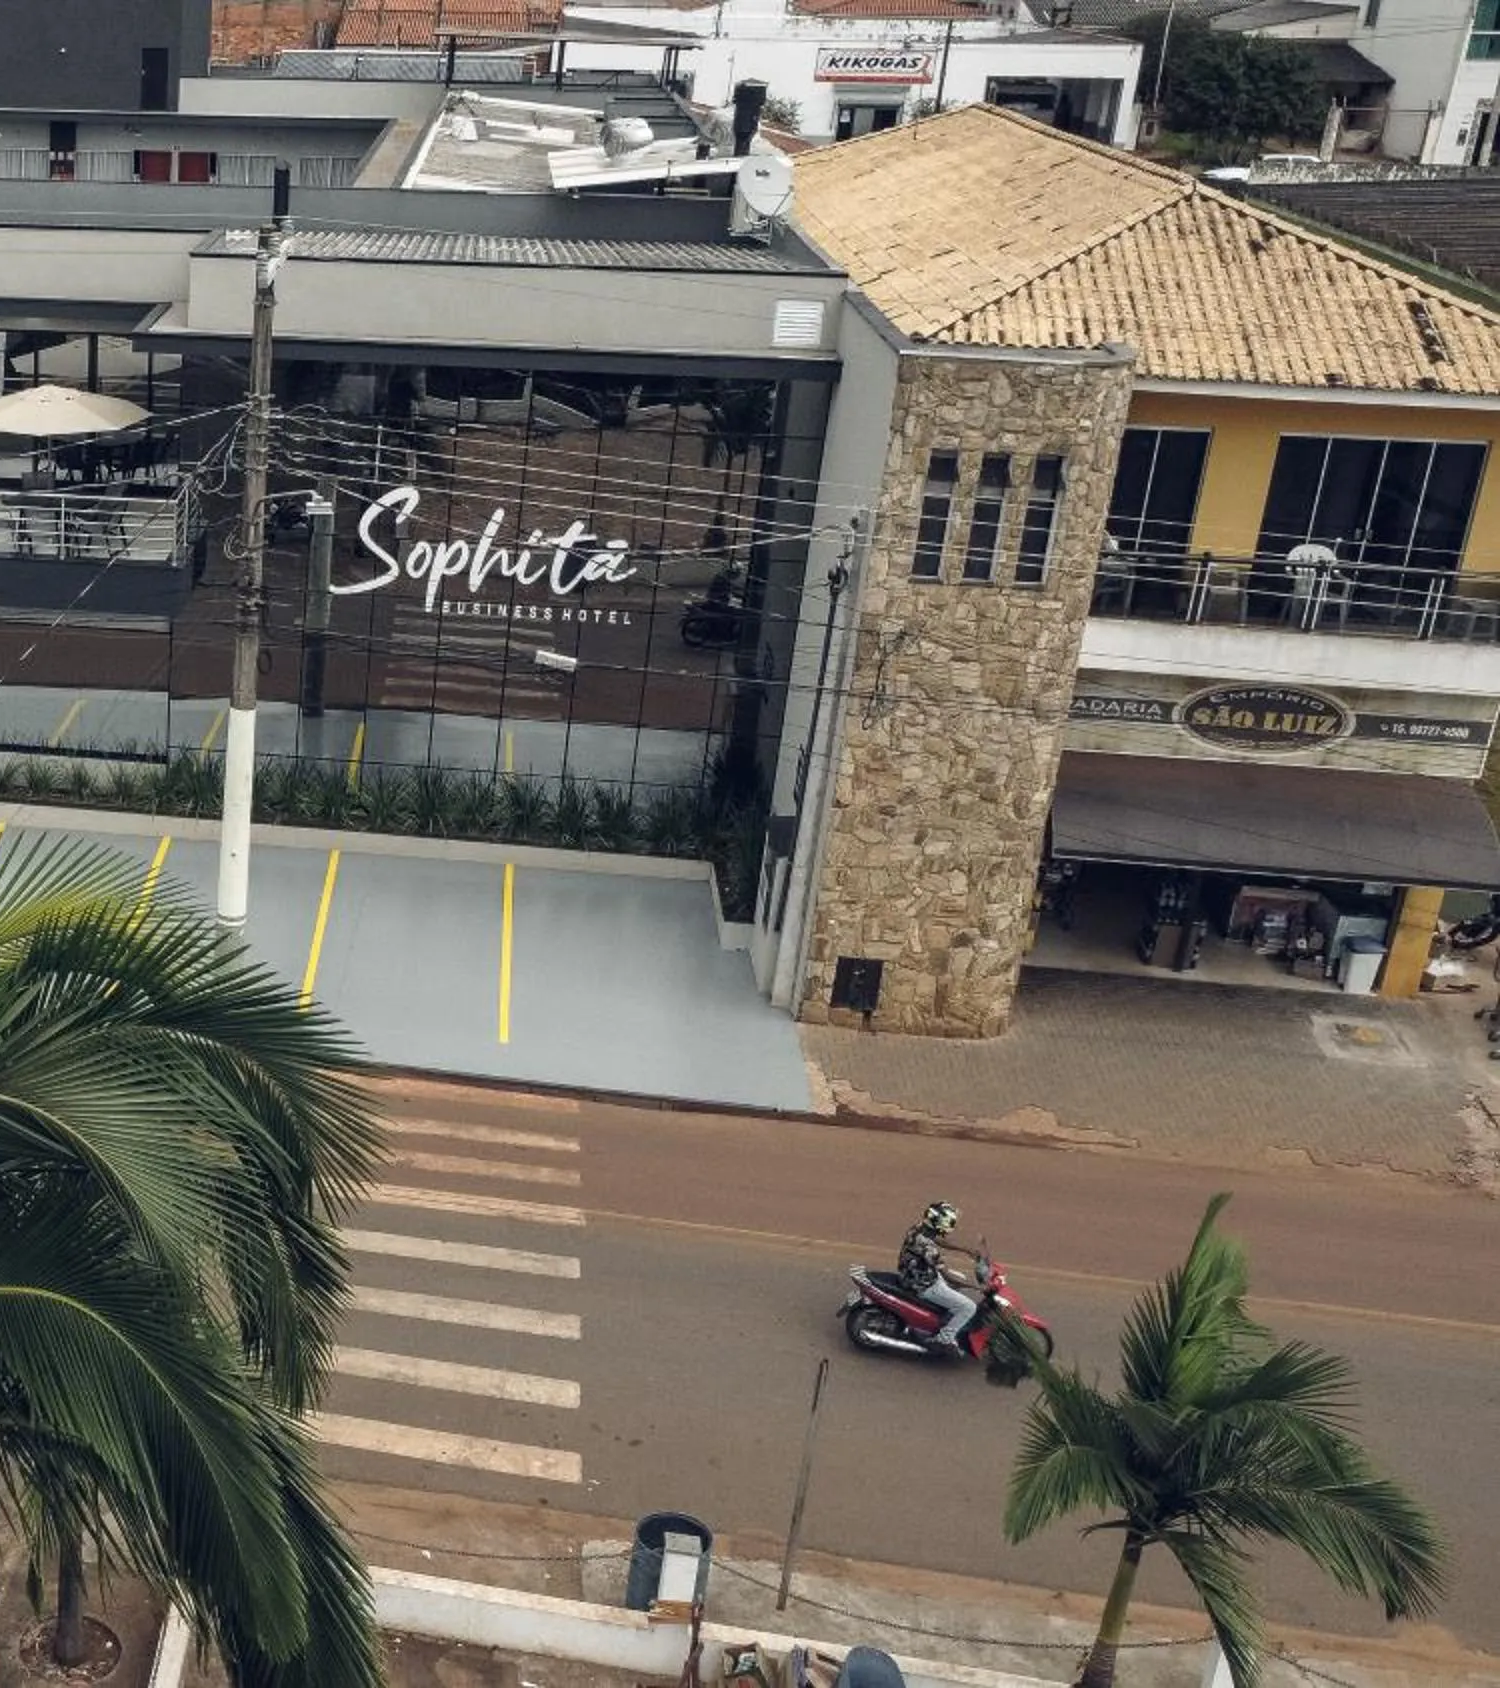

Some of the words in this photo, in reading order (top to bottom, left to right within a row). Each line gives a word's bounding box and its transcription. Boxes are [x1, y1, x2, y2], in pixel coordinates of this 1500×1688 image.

[827, 57, 923, 69] KIKOGAS
[442, 600, 553, 620] BUSINESS
[562, 608, 632, 625] HOTEL
[1071, 698, 1163, 715] ADARIA
[1192, 704, 1256, 729] SÃO
[1263, 710, 1339, 736] LUIZ
